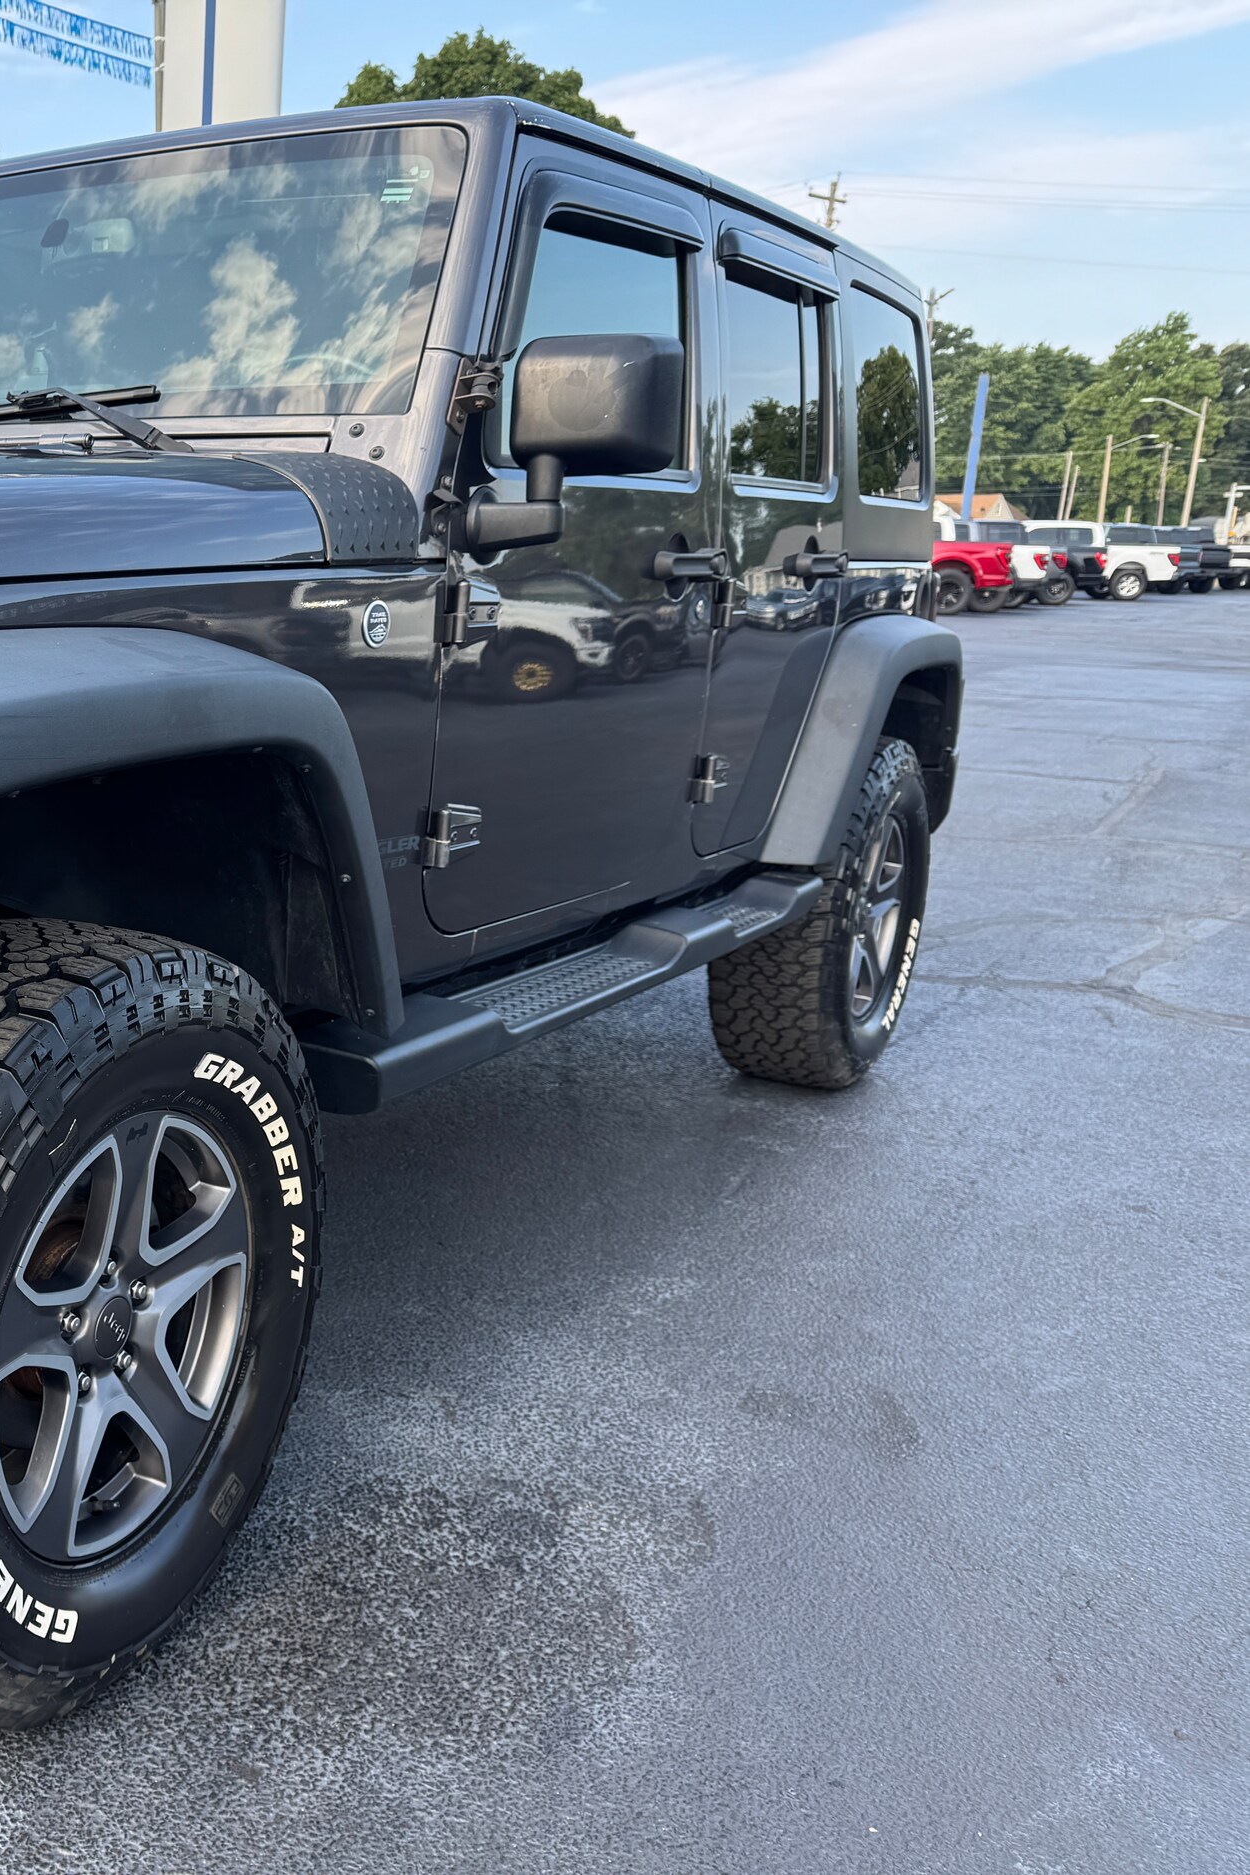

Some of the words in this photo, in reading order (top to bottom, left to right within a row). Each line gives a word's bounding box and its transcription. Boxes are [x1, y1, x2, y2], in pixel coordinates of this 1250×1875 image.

[880, 918, 920, 1031] GENERAL
[193, 1052, 303, 1207] GRABBER
[290, 1223, 305, 1288] A/T
[103, 1312, 126, 1342] Jeep
